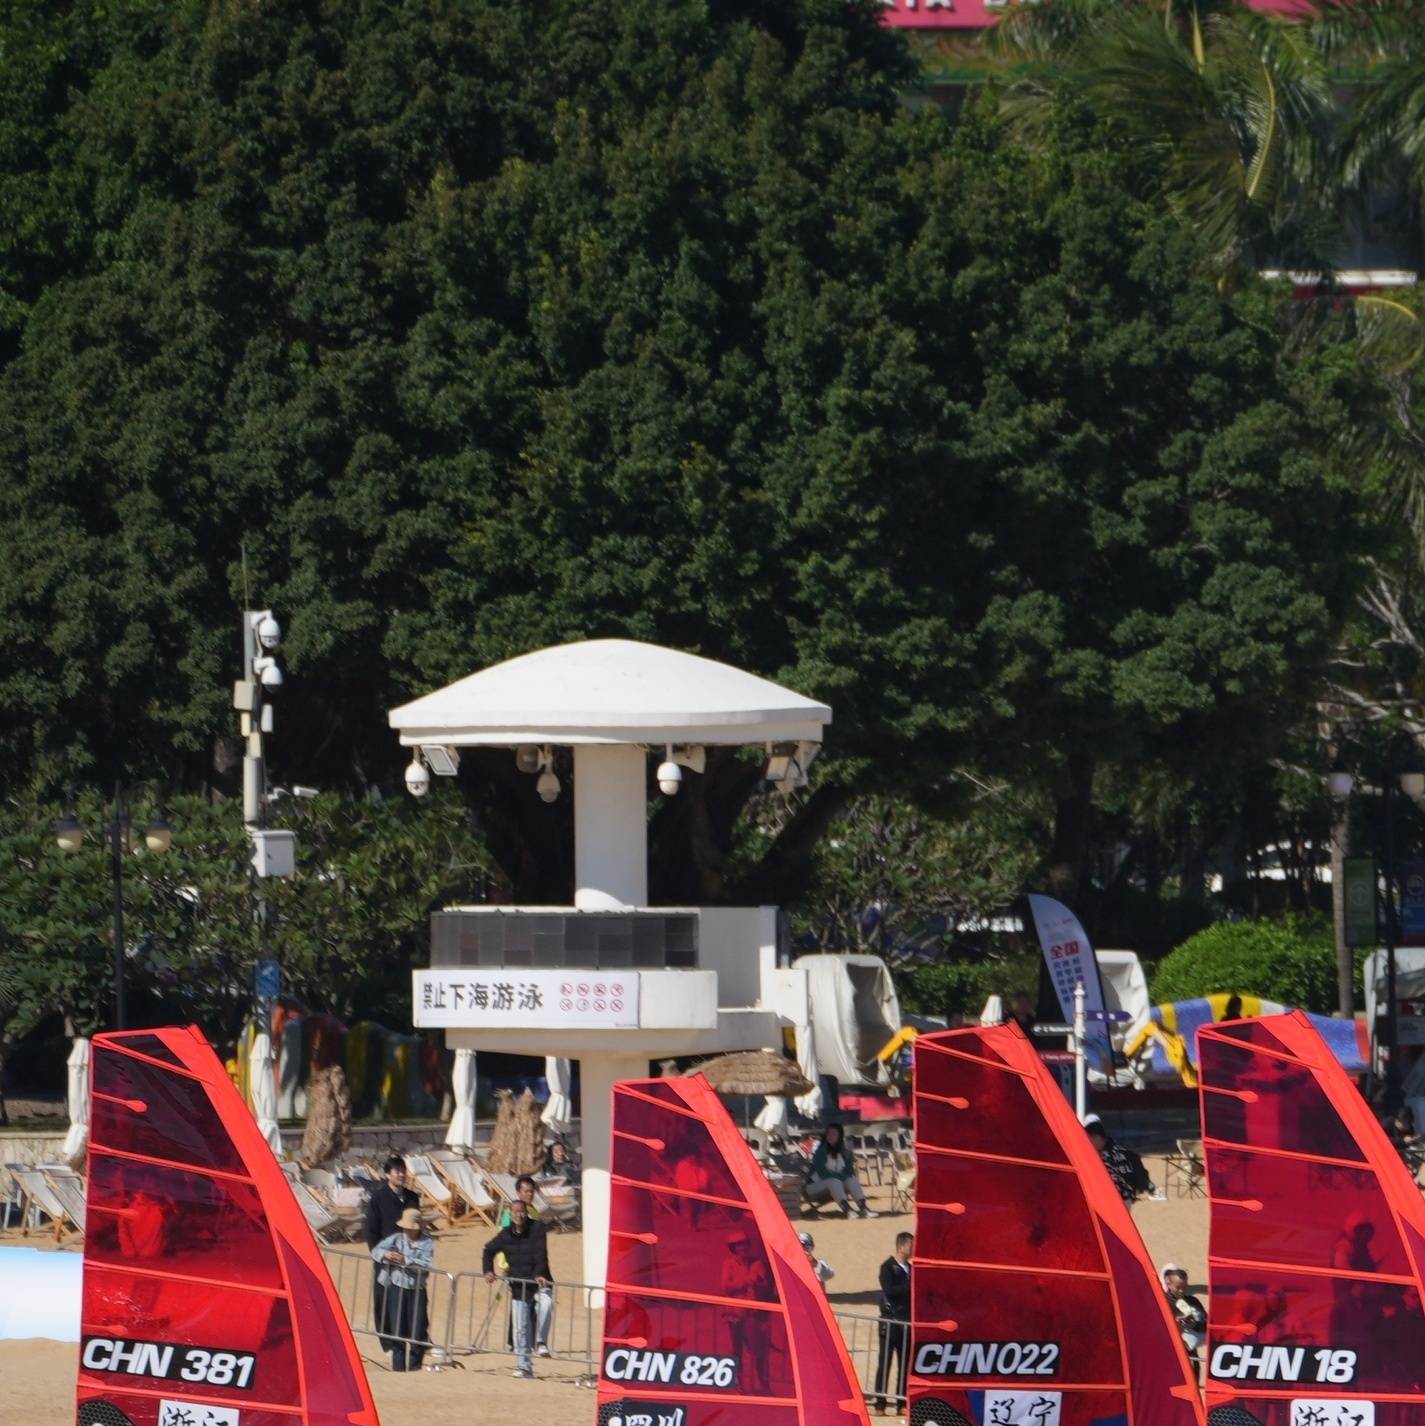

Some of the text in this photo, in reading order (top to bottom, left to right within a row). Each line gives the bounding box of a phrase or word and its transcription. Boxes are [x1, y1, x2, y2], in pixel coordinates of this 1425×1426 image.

[422, 981, 545, 1011] 禁止下海游泳
[82, 1338, 255, 1388] CHN 381
[605, 1349, 735, 1387] CHN 826
[1210, 1344, 1357, 1383] CHN 18
